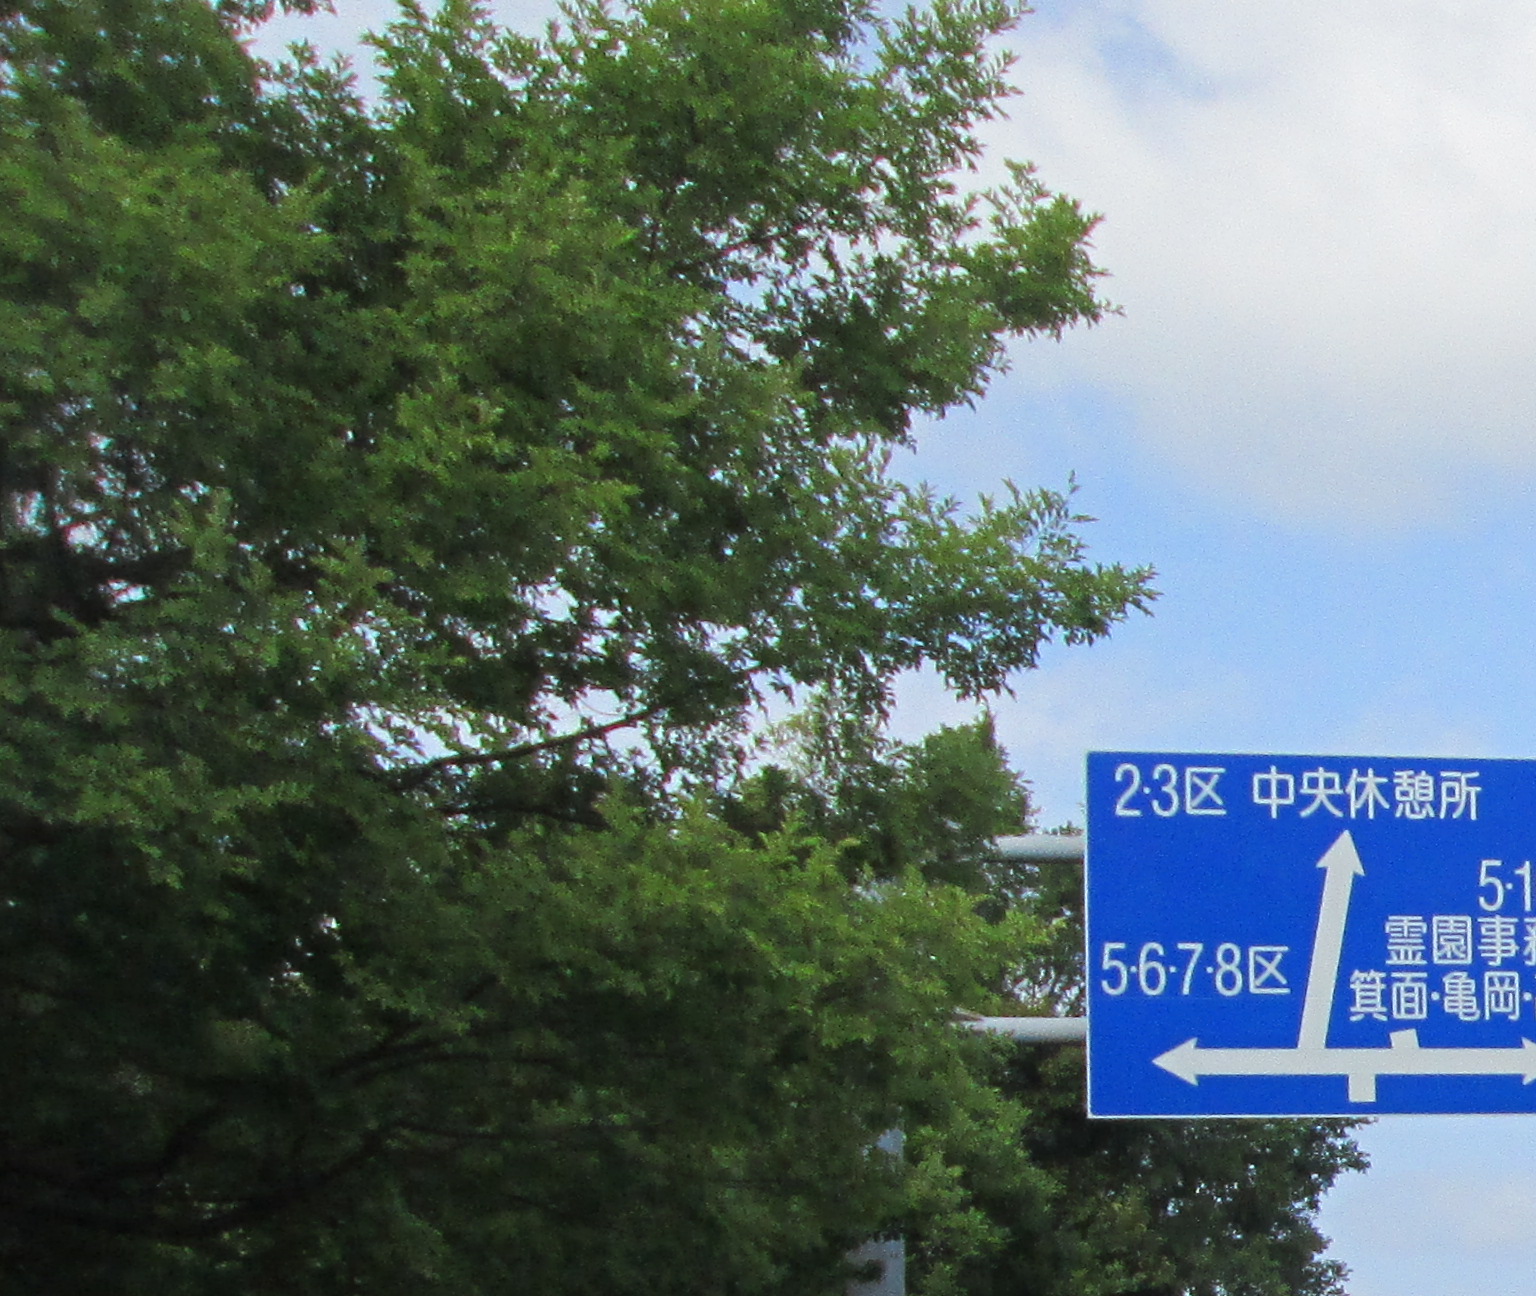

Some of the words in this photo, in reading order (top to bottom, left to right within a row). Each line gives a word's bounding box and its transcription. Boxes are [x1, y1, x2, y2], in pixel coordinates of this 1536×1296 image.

[1252, 765, 1482, 820] 中央休憩所
